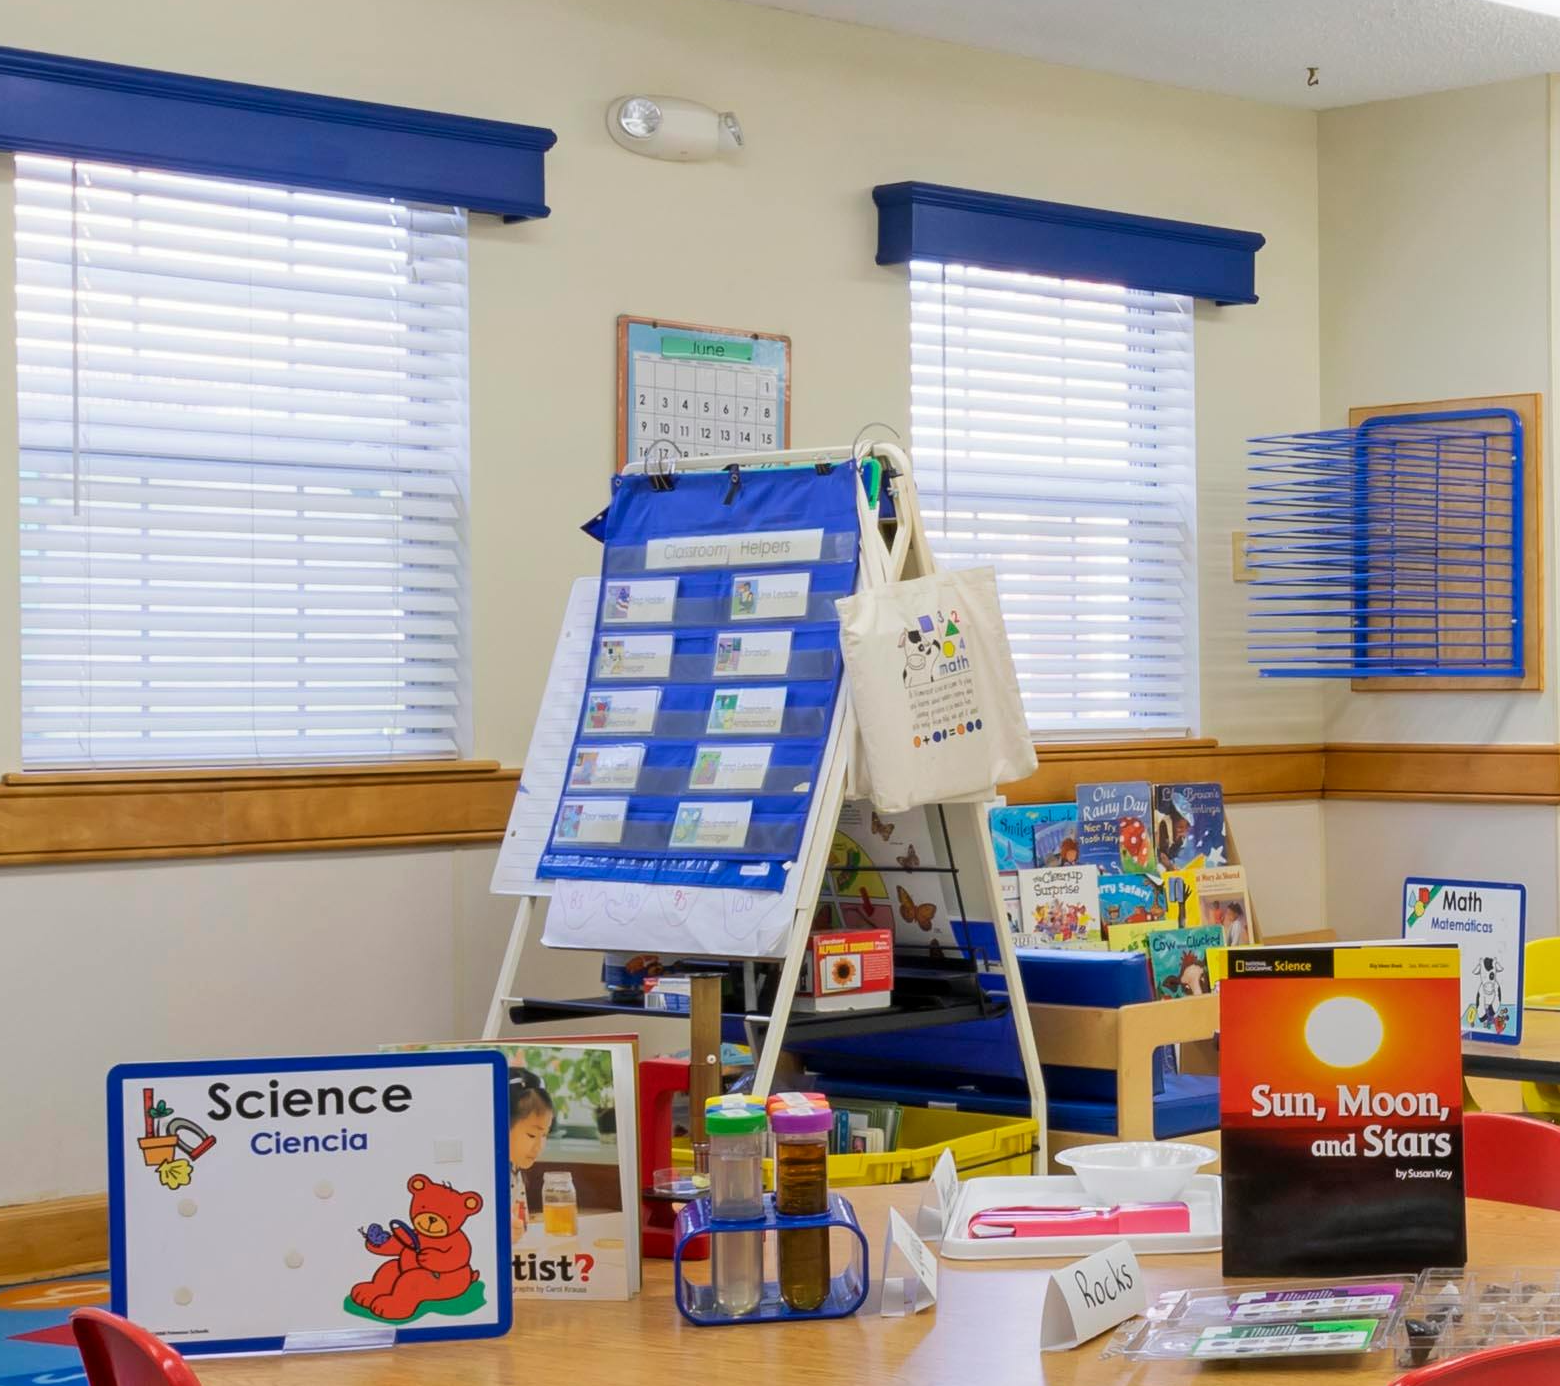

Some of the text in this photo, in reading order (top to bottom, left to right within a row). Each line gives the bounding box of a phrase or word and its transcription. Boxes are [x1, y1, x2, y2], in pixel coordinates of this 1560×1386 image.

[692, 342, 725, 357] June
[639, 394, 770, 418] 2 3 4 5 6 7 8
[641, 421, 772, 445] 9 10 11 12 13 14 15
[664, 538, 792, 560] Classroom Helpers
[951, 610, 960, 623] 2
[959, 637, 966, 650] 4
[1093, 787, 1117, 802] One
[1083, 795, 1148, 821] Rainy Day
[1103, 822, 1117, 833] Try
[1042, 871, 1083, 884] Cleanup
[1034, 884, 1080, 898] Surprise
[1118, 882, 1152, 901] Safari
[1443, 890, 1482, 913] Math
[1431, 917, 1493, 934] Matemáticas
[1153, 938, 1175, 952] Cow
[1187, 932, 1221, 947] Clucked
[1274, 960, 1312, 972] Science
[207, 1079, 413, 1123] Science
[1251, 1083, 1450, 1122] Sun, Moon,
[250, 1128, 368, 1156] Ciencia
[1311, 1124, 1452, 1158] and Stars
[1395, 1169, 1453, 1180] by Susan Kay
[1074, 1259, 1133, 1308] Rocks
